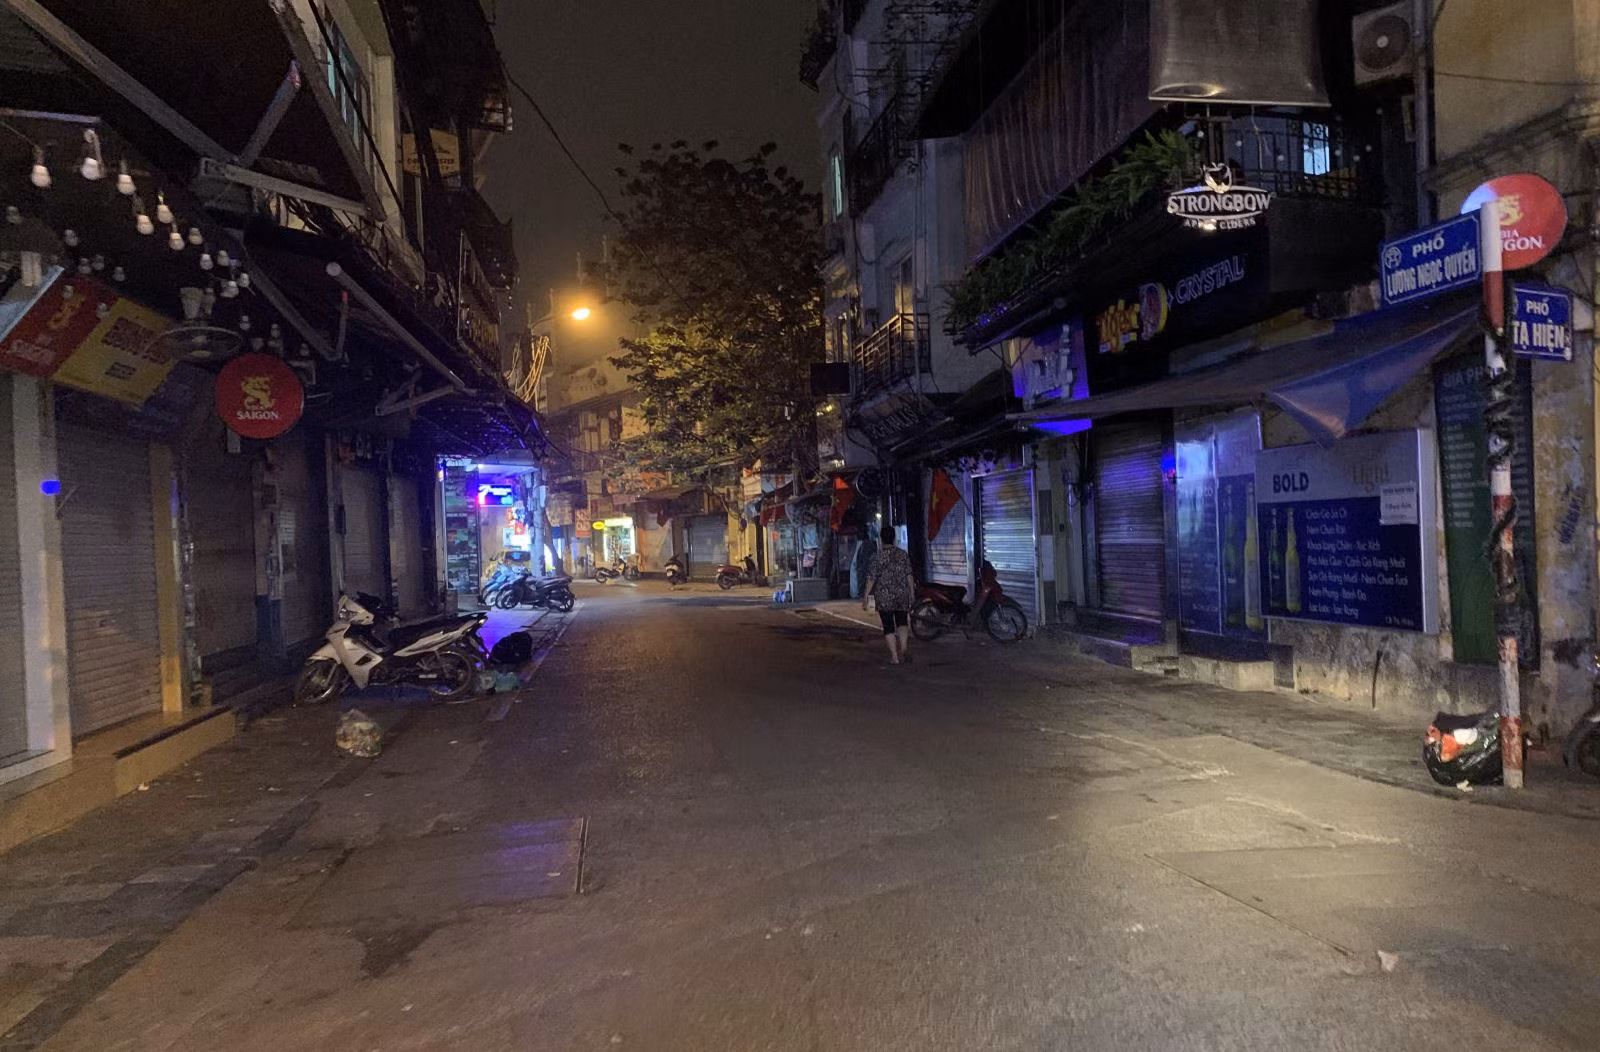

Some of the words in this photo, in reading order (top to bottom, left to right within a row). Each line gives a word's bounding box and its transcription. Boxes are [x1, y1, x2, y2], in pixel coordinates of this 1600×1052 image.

[1167, 193, 1271, 213] STRONGBOW
[1220, 217, 1256, 230] CIDERS
[1412, 231, 1445, 257] PHỐ
[1417, 259, 1443, 290] NGỌC
[1443, 242, 1476, 281] QUYẾN
[1176, 255, 1245, 304] CRYSTAL
[1526, 297, 1549, 315] PHỐ
[1512, 321, 1529, 350] TẠ
[1532, 318, 1565, 353] HIỆN
[236, 410, 279, 420] SAIGON
[1272, 472, 1309, 493] BOLD
